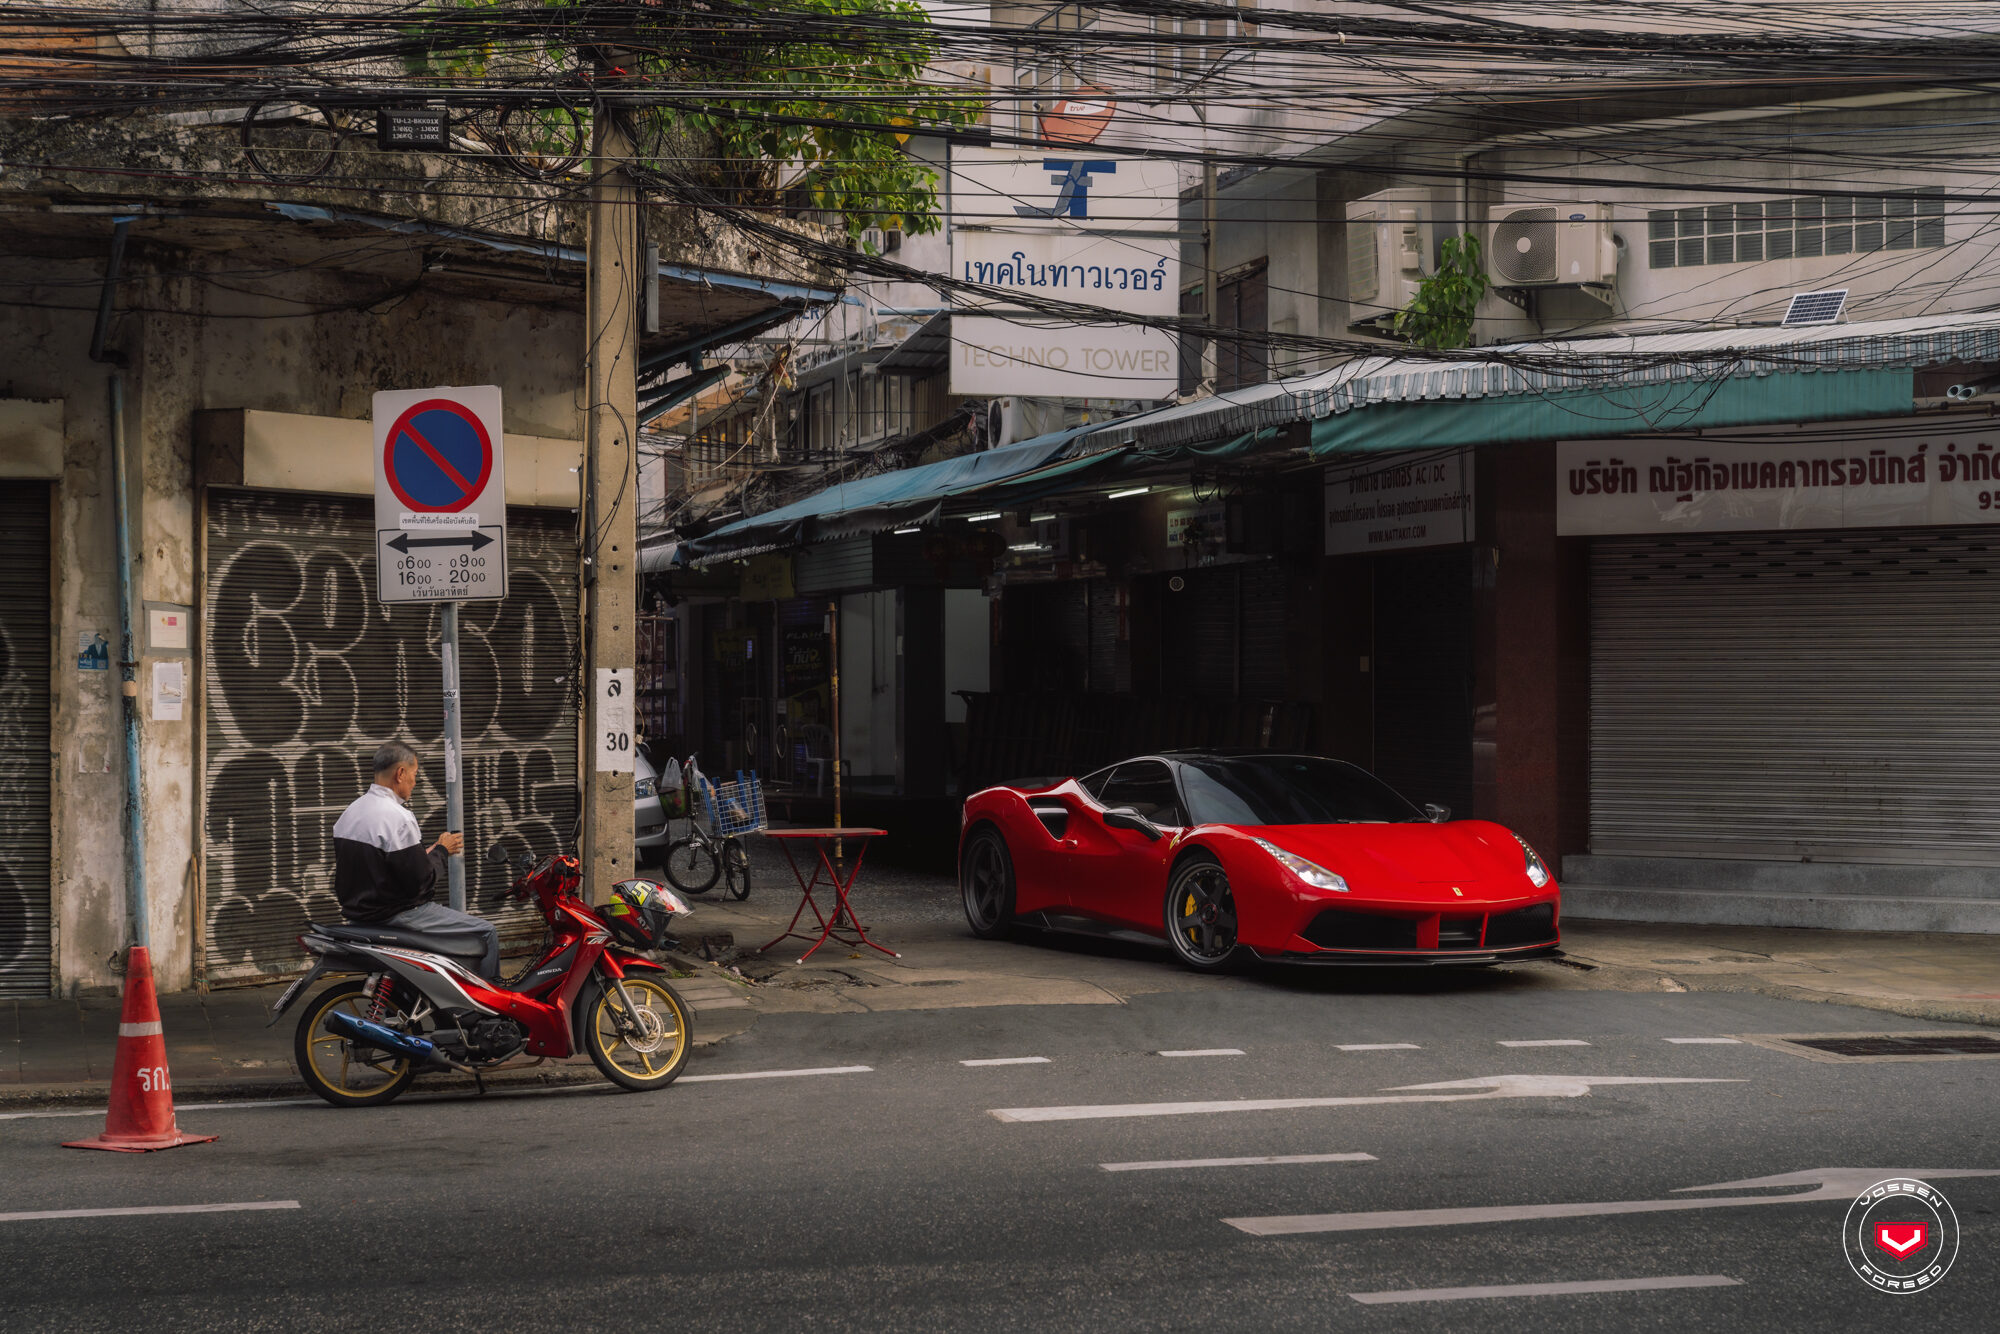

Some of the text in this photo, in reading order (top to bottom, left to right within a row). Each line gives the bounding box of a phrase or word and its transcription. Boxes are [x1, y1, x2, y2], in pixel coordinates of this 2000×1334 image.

[1069, 104, 1086, 112] true
[964, 251, 1168, 291] เทคโนทาวเวอร์
[960, 343, 1170, 373] TECHNO TOWER
[1415, 466, 1427, 485] AC
[1434, 463, 1446, 482] DC
[1569, 457, 1637, 496] บริษัท
[412, 585, 468, 598] เว้นวันอาทิตย์
[606, 732, 629, 751] 30
[536, 967, 562, 976] HONDA
[136, 1064, 171, 1092] รก
